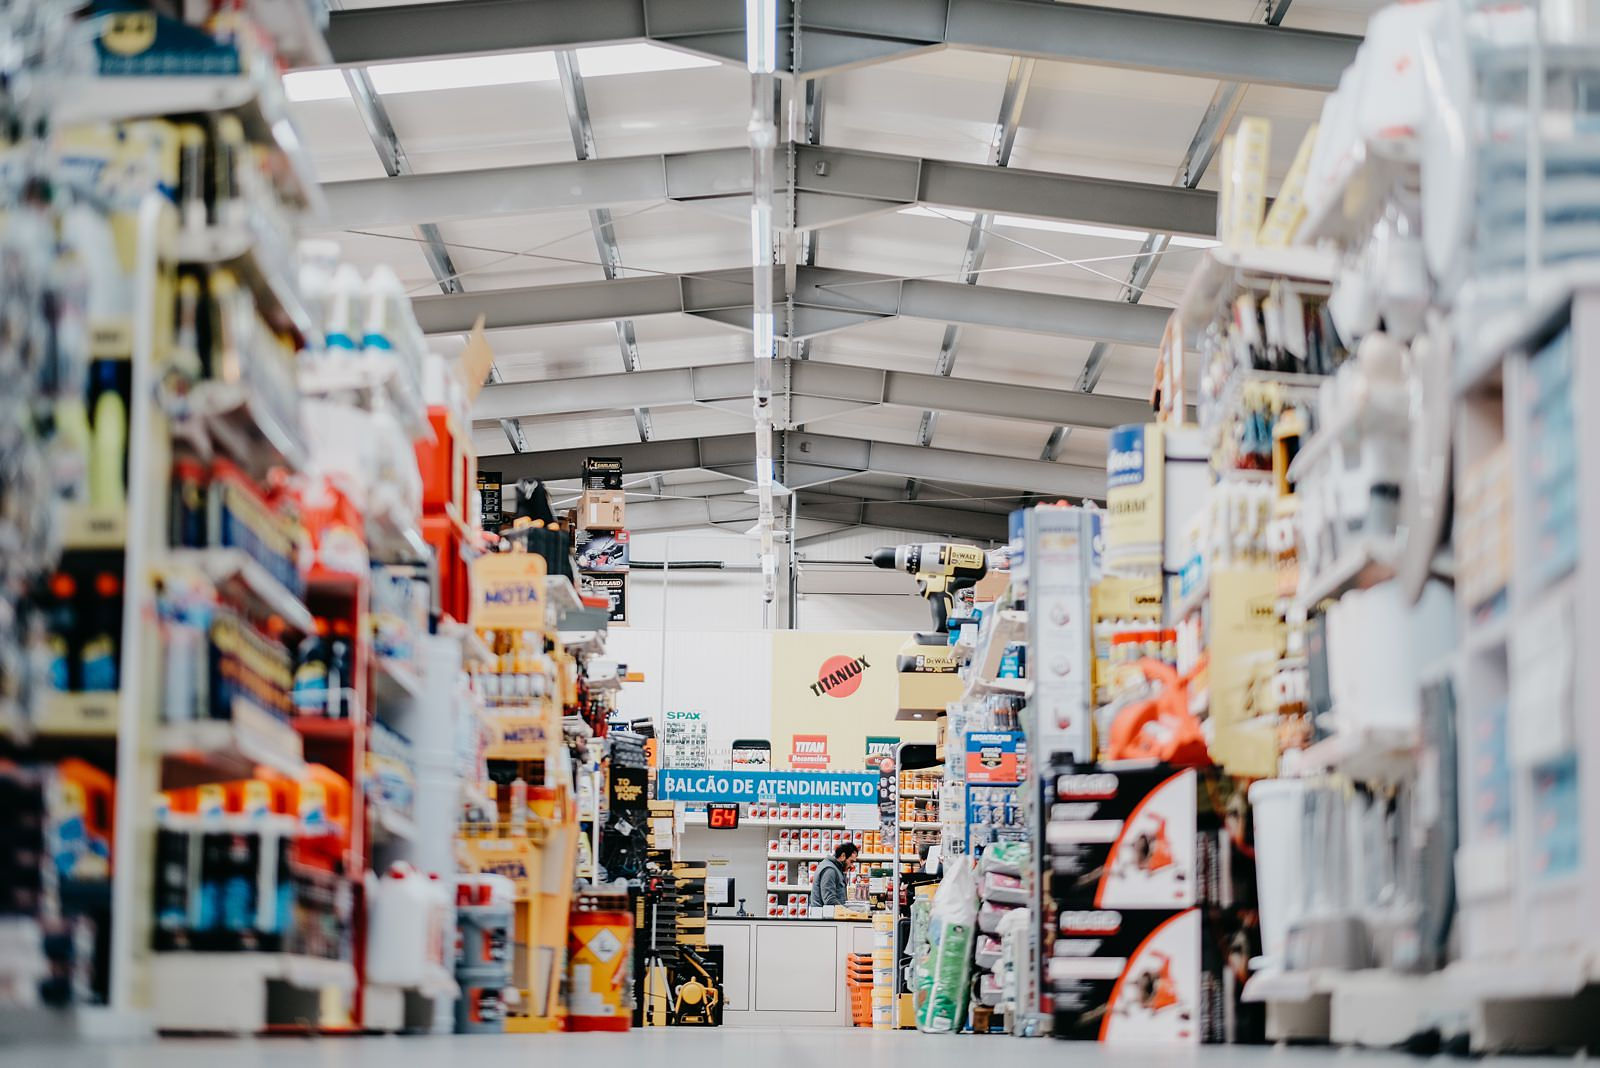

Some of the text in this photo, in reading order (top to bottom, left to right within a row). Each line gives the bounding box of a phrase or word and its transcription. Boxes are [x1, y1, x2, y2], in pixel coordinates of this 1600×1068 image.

[594, 579, 622, 587] GARLAND
[485, 585, 538, 605] MOTA
[810, 655, 871, 697] TITANLUX
[666, 711, 701, 720] SPAX
[795, 741, 825, 753] TITAN
[617, 778, 630, 786] TO
[664, 775, 874, 797] BALCÃO DE ATENDIMENTO
[711, 809, 736, 826] 64
